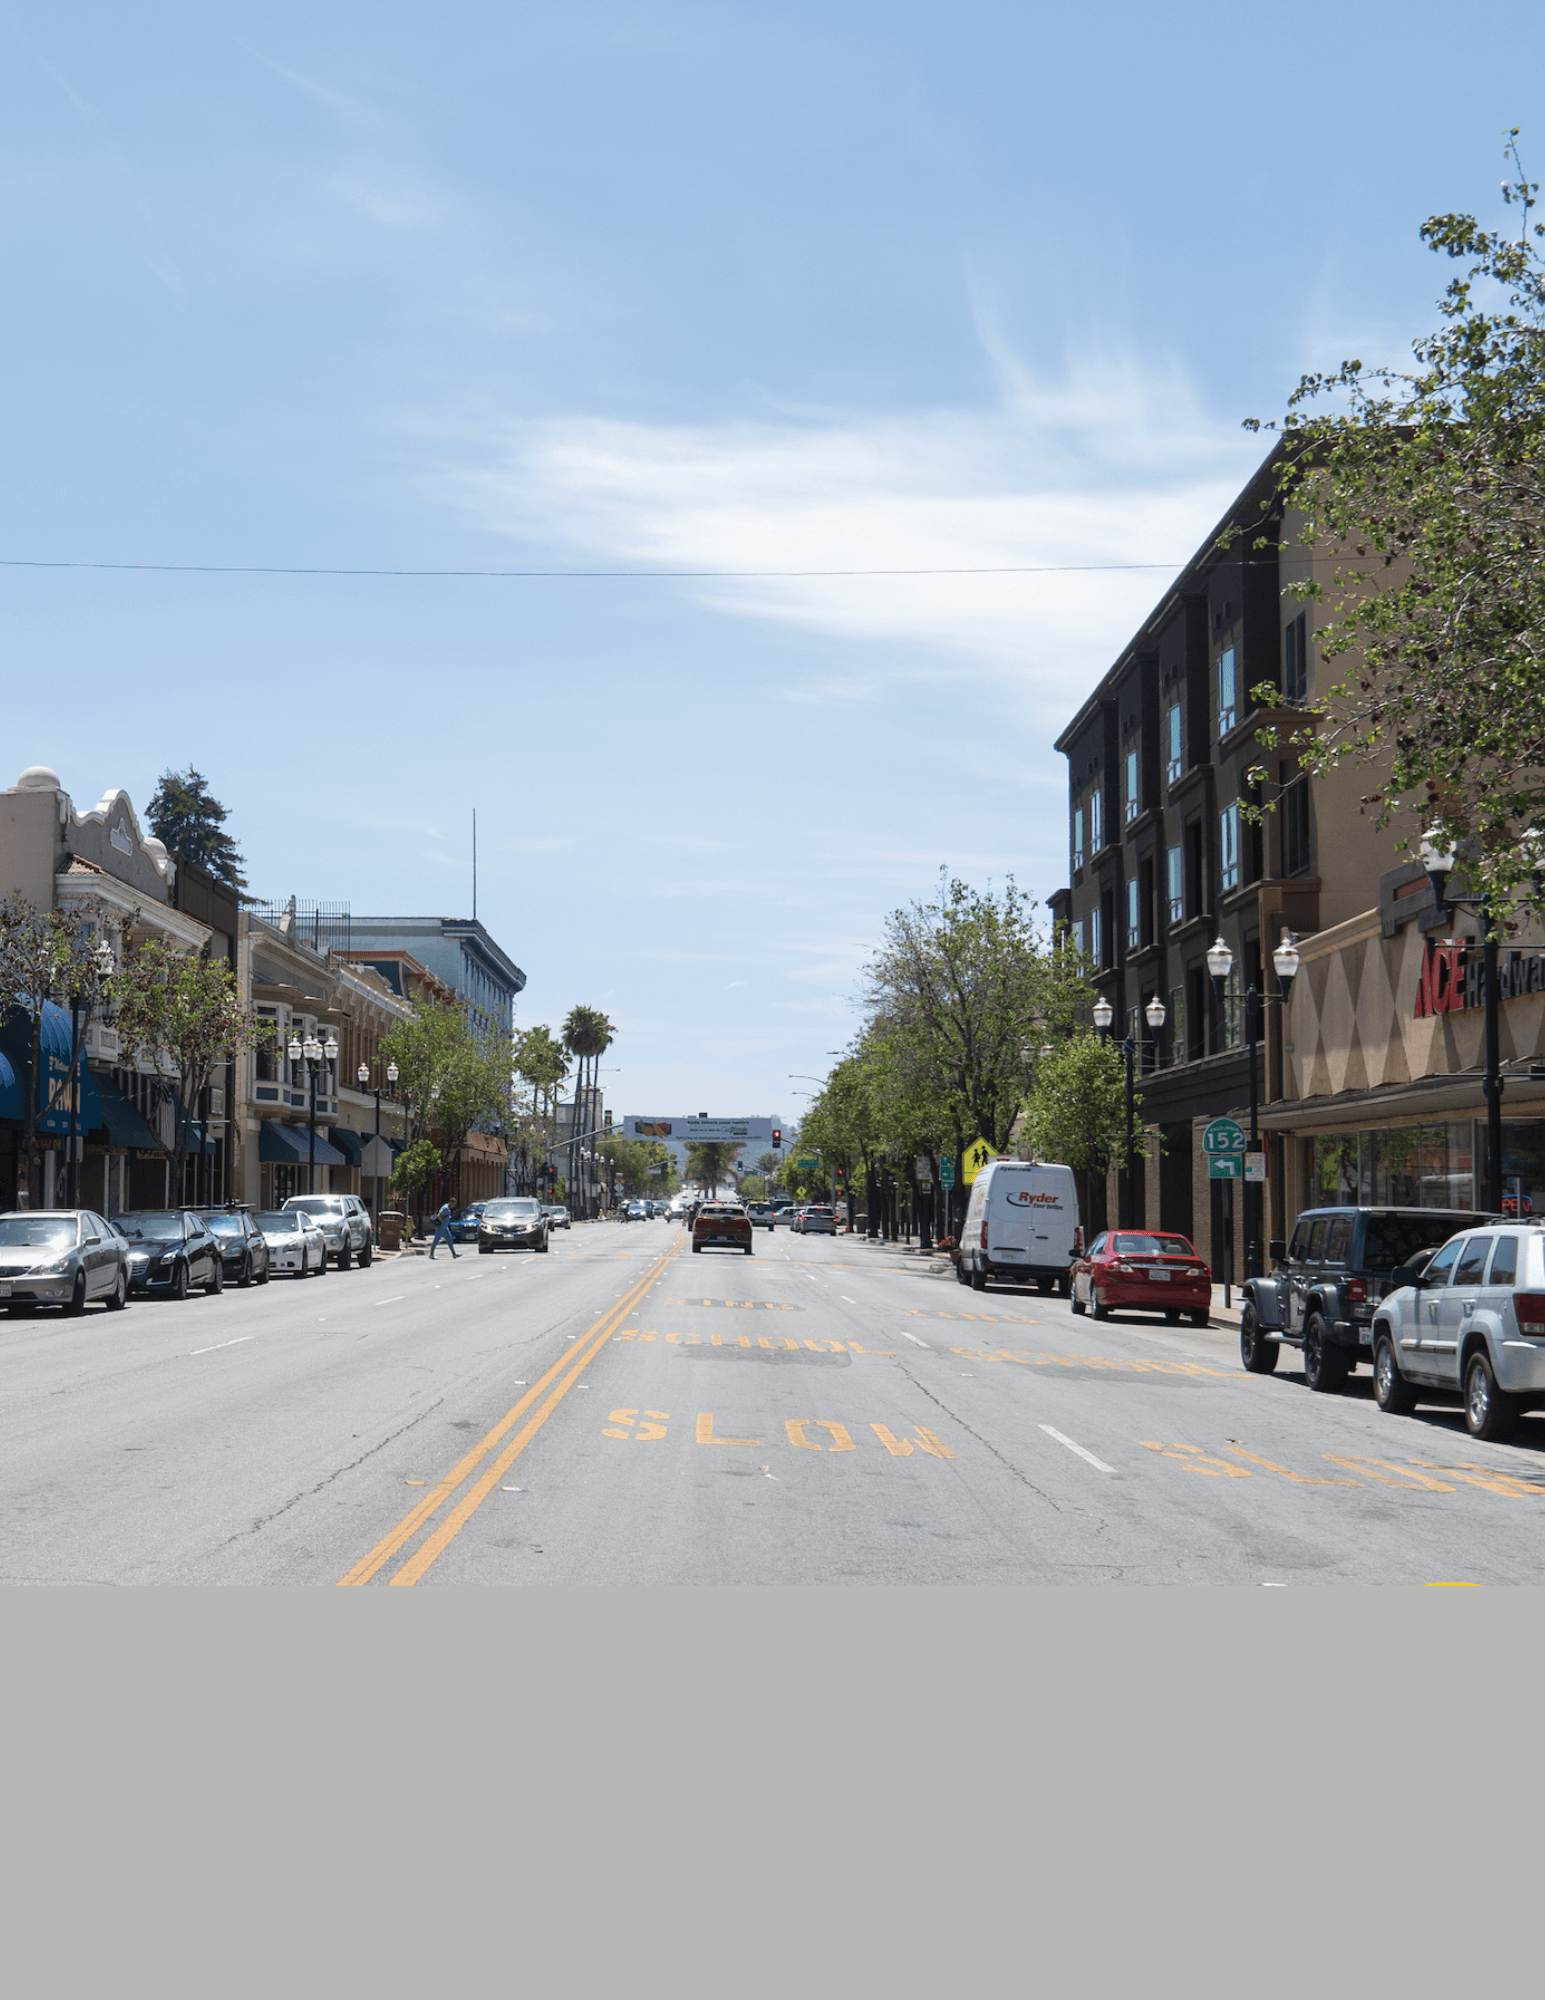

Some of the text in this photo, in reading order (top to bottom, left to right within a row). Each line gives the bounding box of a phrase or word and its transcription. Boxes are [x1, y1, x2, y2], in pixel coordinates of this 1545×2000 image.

[1413, 936, 1545, 1018] ACE Hdwa
[1208, 1132, 1245, 1149] 152
[1019, 1192, 1059, 1204] Ryder
[1501, 1198, 1531, 1212] PEN
[617, 1329, 897, 1356] SCHOOL
[949, 1347, 1258, 1379] SCHOOL
[601, 1409, 958, 1460] SLOW
[1139, 1441, 1545, 1499] SLOW
